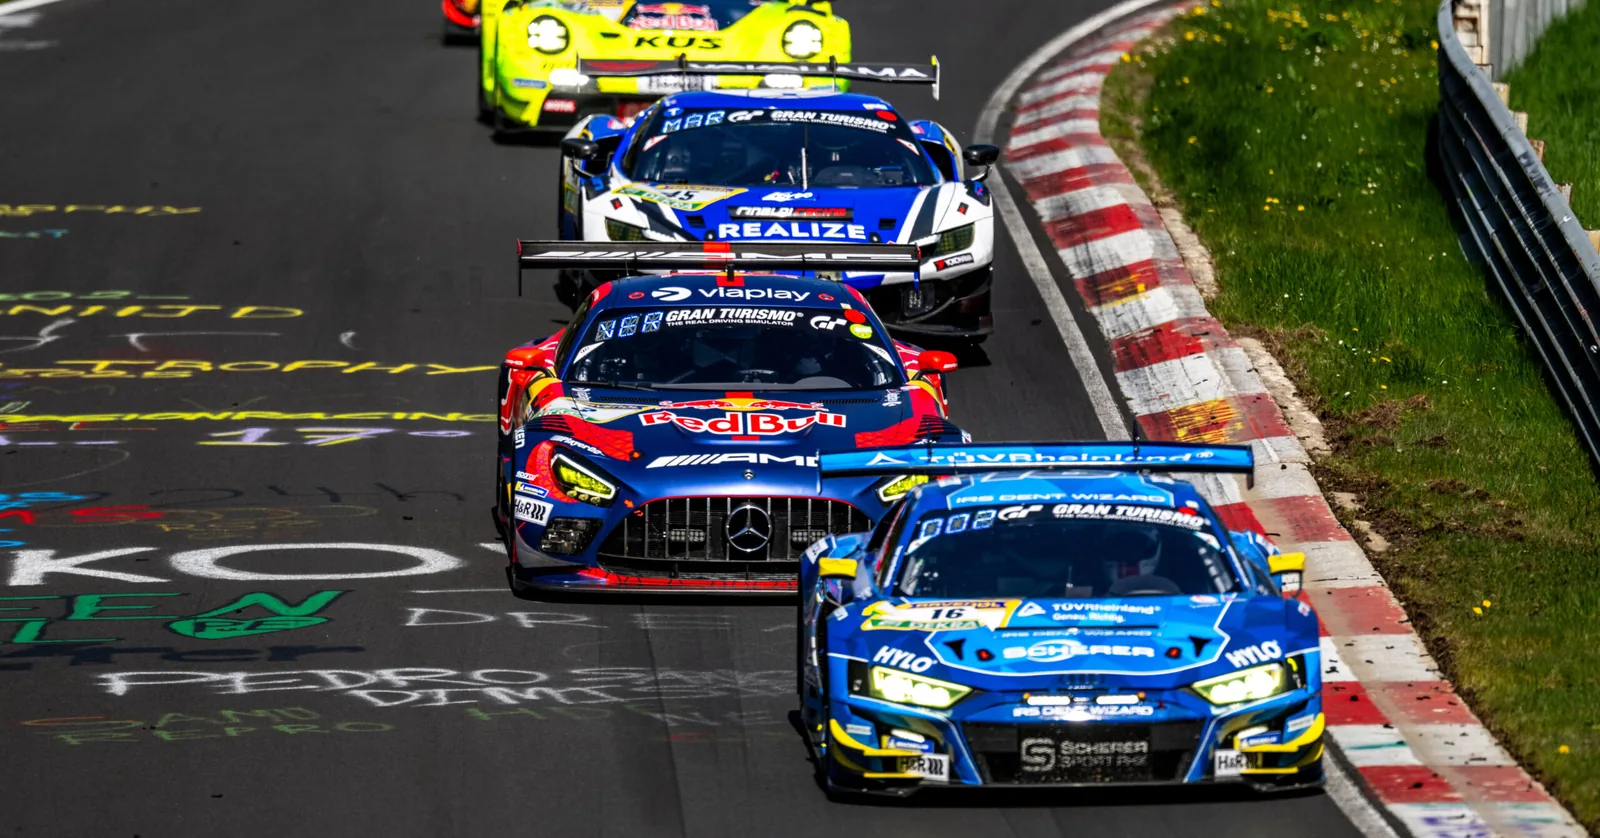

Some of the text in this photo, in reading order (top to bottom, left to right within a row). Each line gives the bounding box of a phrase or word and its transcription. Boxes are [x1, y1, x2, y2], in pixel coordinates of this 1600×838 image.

[634, 36, 722, 49] KUS
[661, 110, 726, 133] MAR
[771, 110, 817, 120] GRAN
[718, 223, 867, 240] REALIZE
[698, 286, 811, 302] viaplay
[665, 308, 714, 322] GRAN
[597, 311, 664, 341] VER
[745, 319, 793, 327] SIMULATOR
[56, 360, 498, 374] TROPHY
[637, 411, 847, 435] Red Bull
[956, 493, 1166, 504] IRS DENT WIZARD
[1052, 504, 1111, 514] GRAN
[931, 608, 967, 620] 16
[909, 620, 977, 629] DEKRA
[1003, 644, 1155, 659] SCHERER
[1225, 640, 1283, 668] HYLO
[872, 646, 933, 673] HYLO
[97, 667, 550, 697] PEDRO
[1013, 706, 1040, 717] IRS
[1089, 705, 1154, 716] WIZARD
[1217, 753, 1246, 769] H&R
